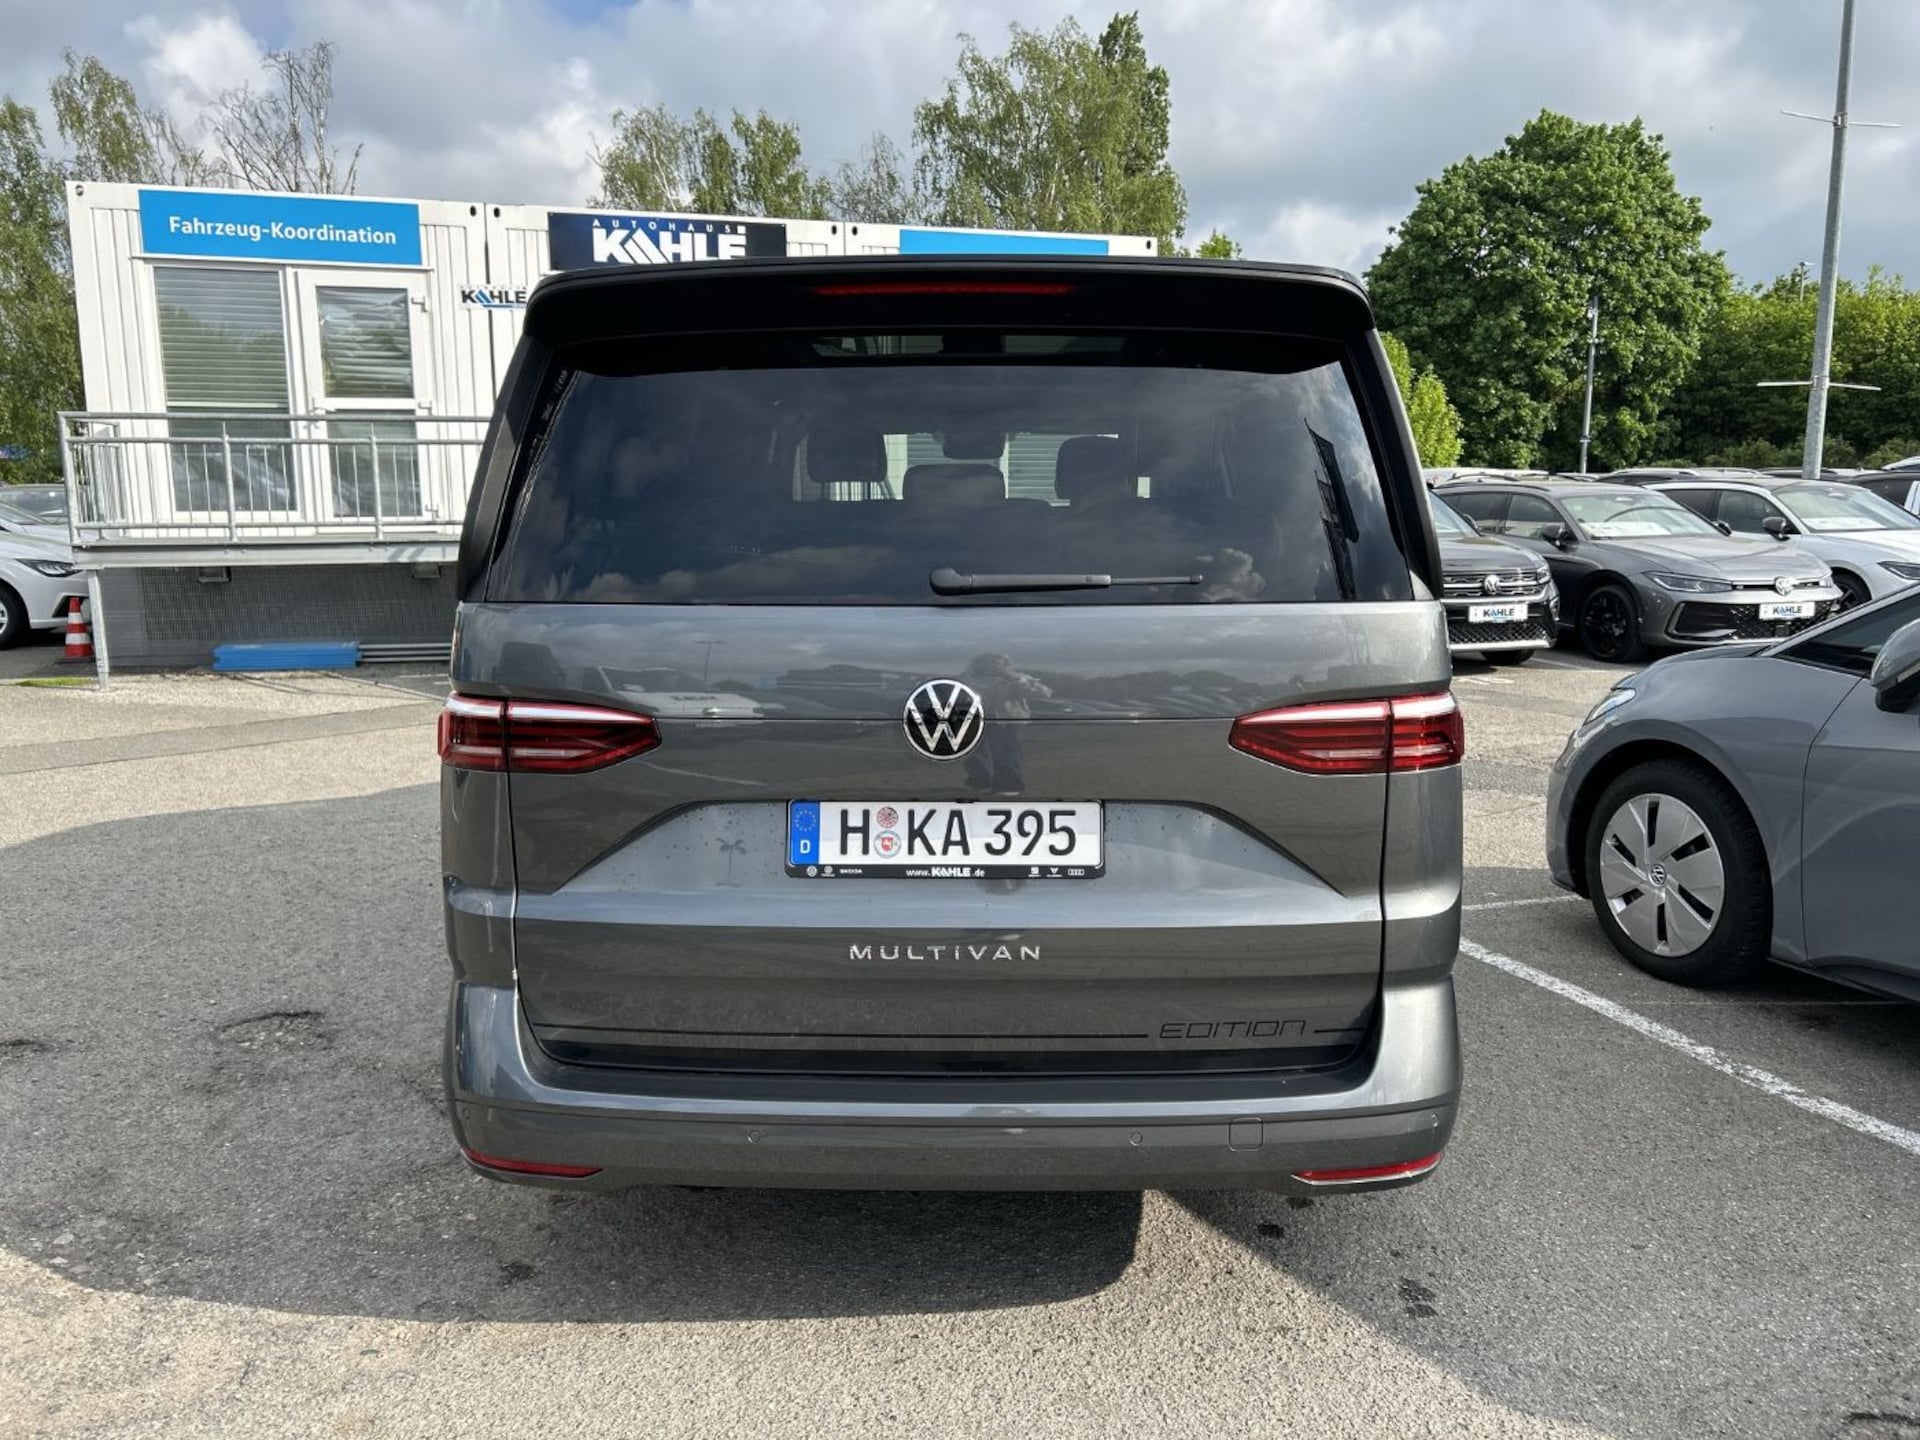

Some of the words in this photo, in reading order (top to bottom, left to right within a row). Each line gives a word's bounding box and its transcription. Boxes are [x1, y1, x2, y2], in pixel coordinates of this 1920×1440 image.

[169, 216, 397, 245] Fahrzeug-Koordination
[592, 218, 732, 233] AUTOHAUS
[592, 225, 747, 264] KAHLE
[840, 808, 870, 856] H
[907, 808, 971, 856] KA
[984, 808, 1077, 857] 395
[800, 839, 811, 855] D
[849, 945, 1041, 961] MULTIVAN
[1159, 1020, 1306, 1039] EDITION
